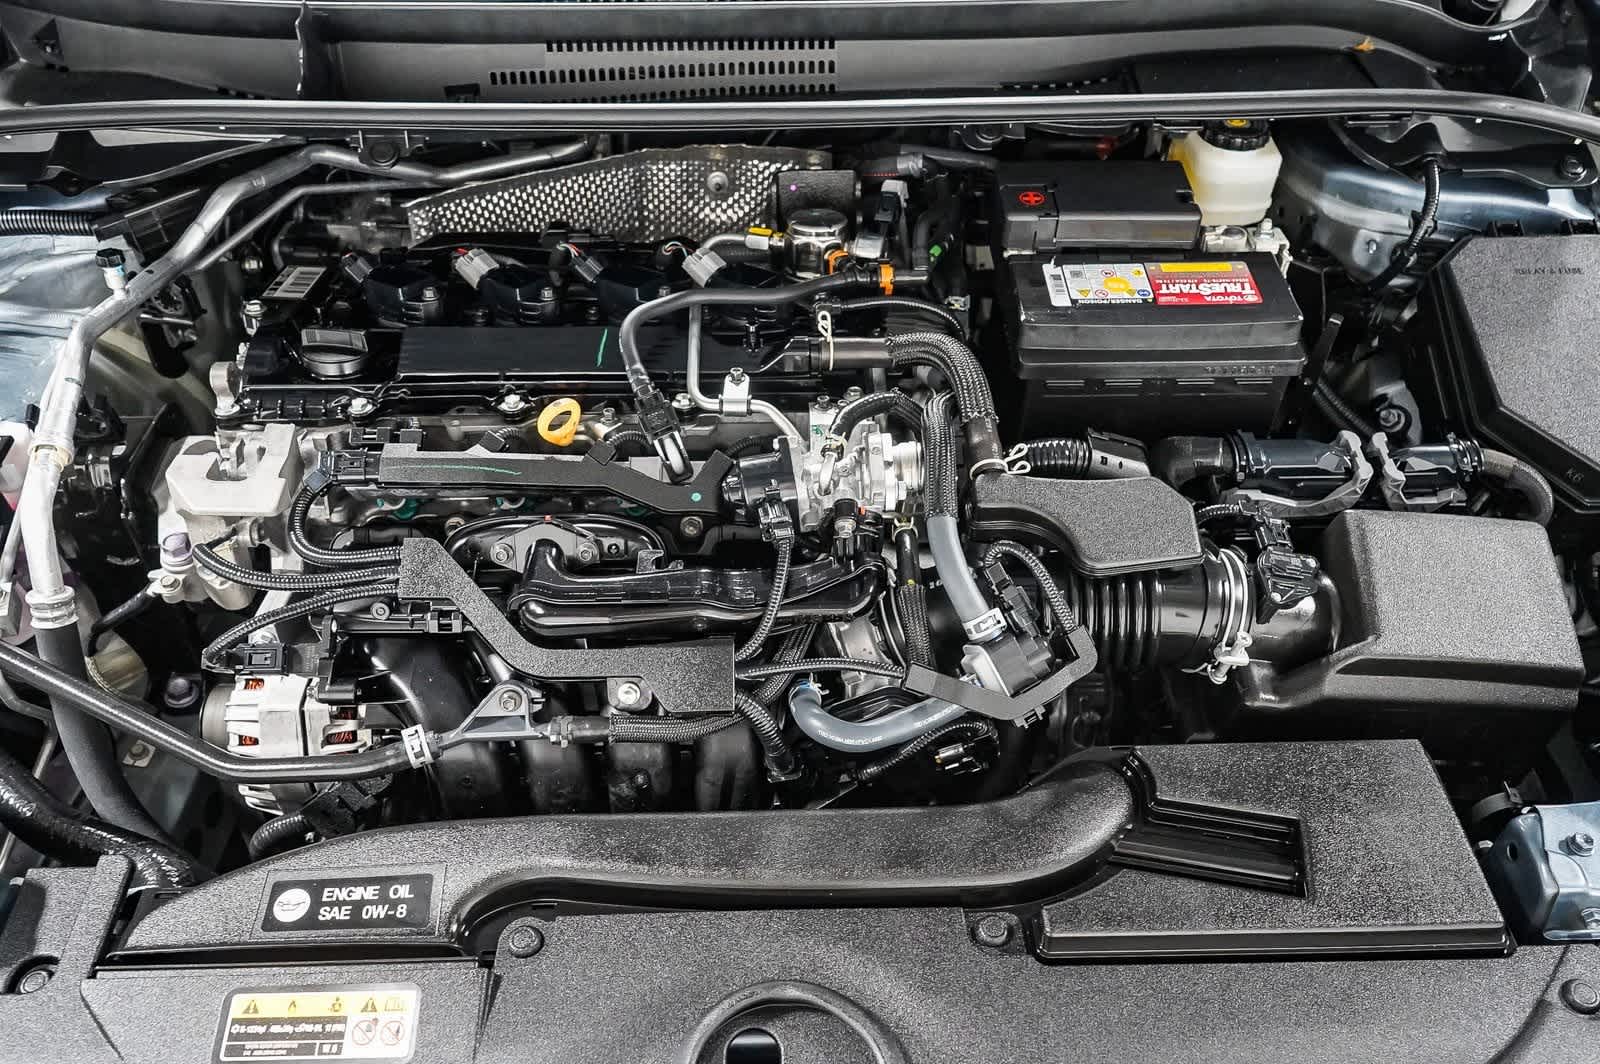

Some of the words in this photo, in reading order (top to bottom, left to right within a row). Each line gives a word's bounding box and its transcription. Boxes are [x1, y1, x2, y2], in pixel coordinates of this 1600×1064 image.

[1203, 295, 1244, 303] TOYOTA
[321, 885, 380, 901] ENGINE
[389, 884, 414, 899] OIL
[318, 905, 352, 921] SAE
[361, 904, 407, 920] 0W-8
